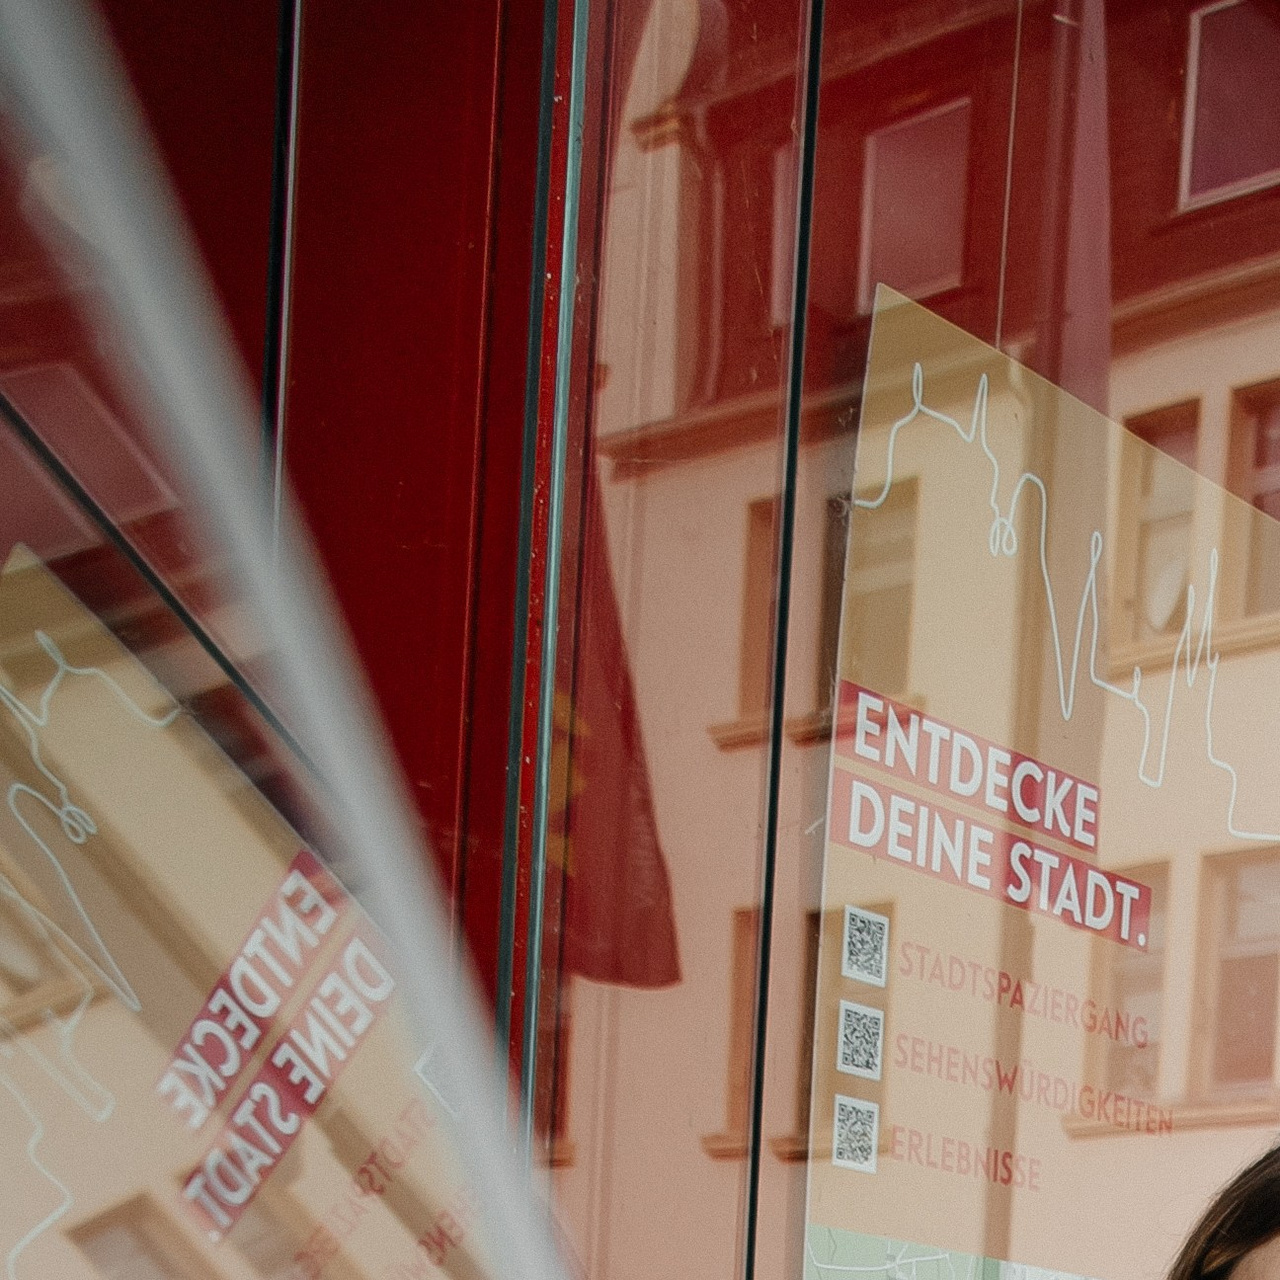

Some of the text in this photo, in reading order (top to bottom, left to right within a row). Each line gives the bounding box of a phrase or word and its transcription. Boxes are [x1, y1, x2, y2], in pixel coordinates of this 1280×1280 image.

[854, 691, 1098, 847] ENTDECKE
[849, 780, 1147, 947] DEINE STADT.
[898, 941, 1149, 1049] STADTSPAZIERGANG
[894, 1033, 1174, 1135] SEHENSWÜRDIGKEITEN
[890, 1126, 1041, 1190] ERLEBNISSE
